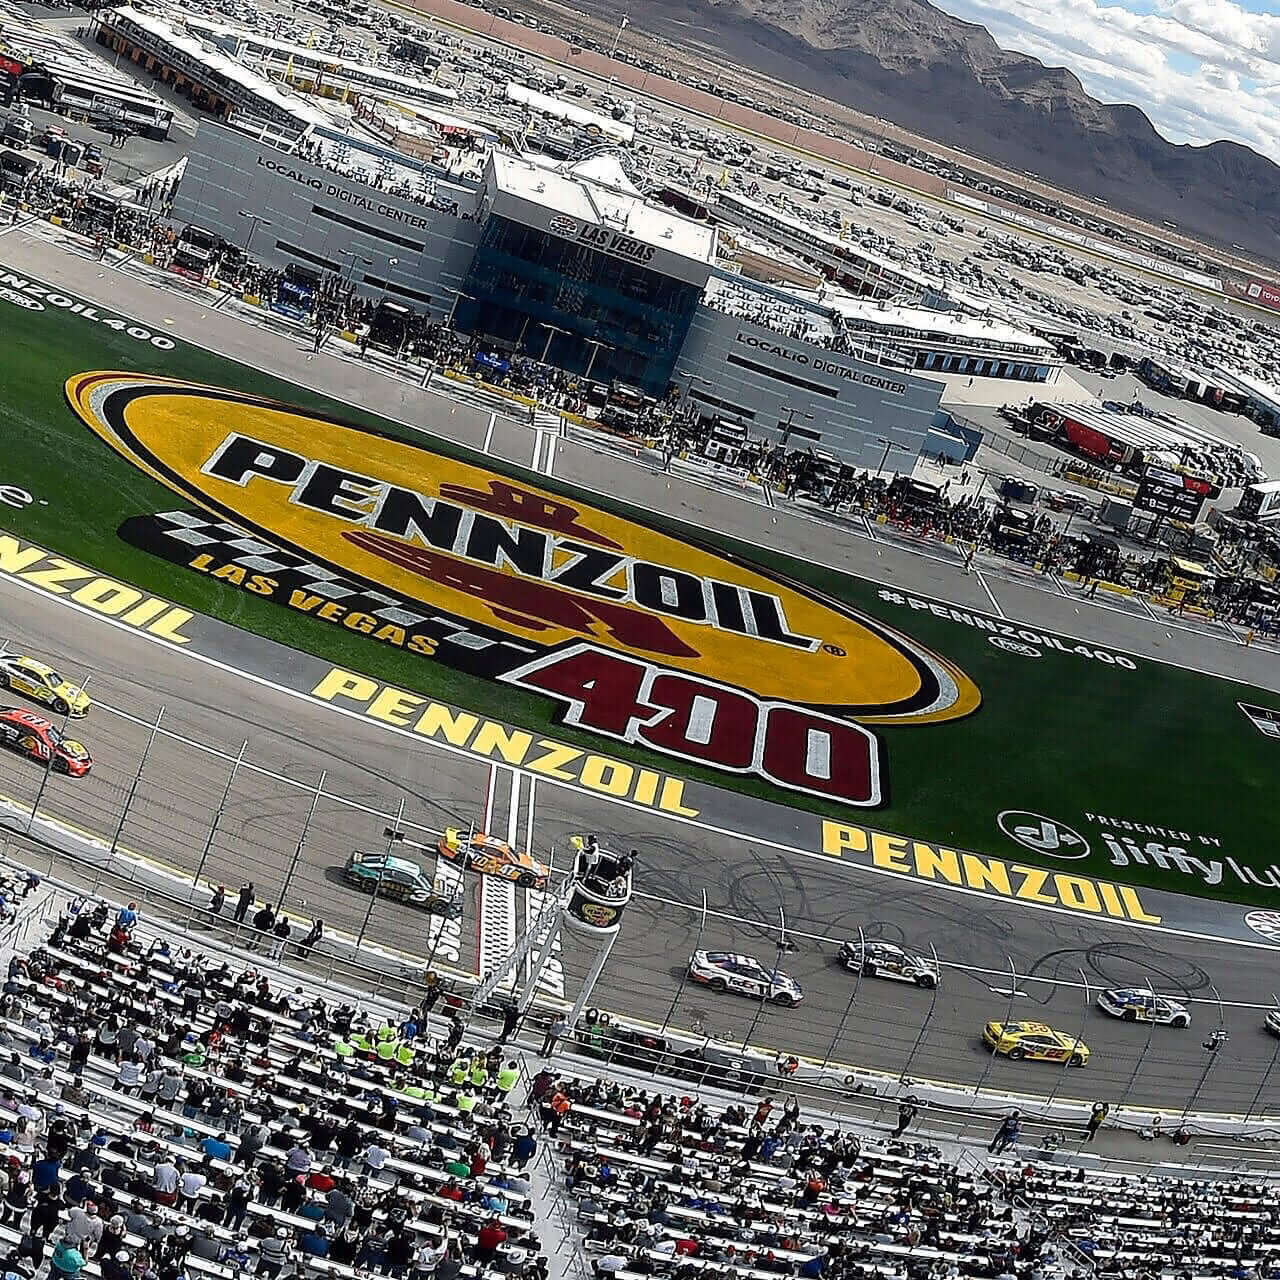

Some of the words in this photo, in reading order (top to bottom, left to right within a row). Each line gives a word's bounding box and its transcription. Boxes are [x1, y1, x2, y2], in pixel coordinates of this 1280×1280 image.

[327, 185, 375, 213] DIGITAL
[377, 204, 428, 230] CENTER
[580, 224, 610, 245] LAS
[609, 232, 656, 261] VEGAS
[813, 358, 860, 382] DIGITAL
[862, 374, 906, 395] CENTER
[201, 431, 824, 654] PENNZOIL
[187, 552, 274, 598] LAS
[286, 589, 439, 655] VEGAS
[877, 589, 1138, 671] #PENNZOIL400
[311, 667, 700, 819] PENNZOIL
[503, 641, 885, 807] 400
[1084, 811, 1193, 843] PRESENTED
[1198, 835, 1222, 849] BY
[1100, 832, 1224, 885] jiffy
[821, 820, 1162, 924] PENNZOIL
